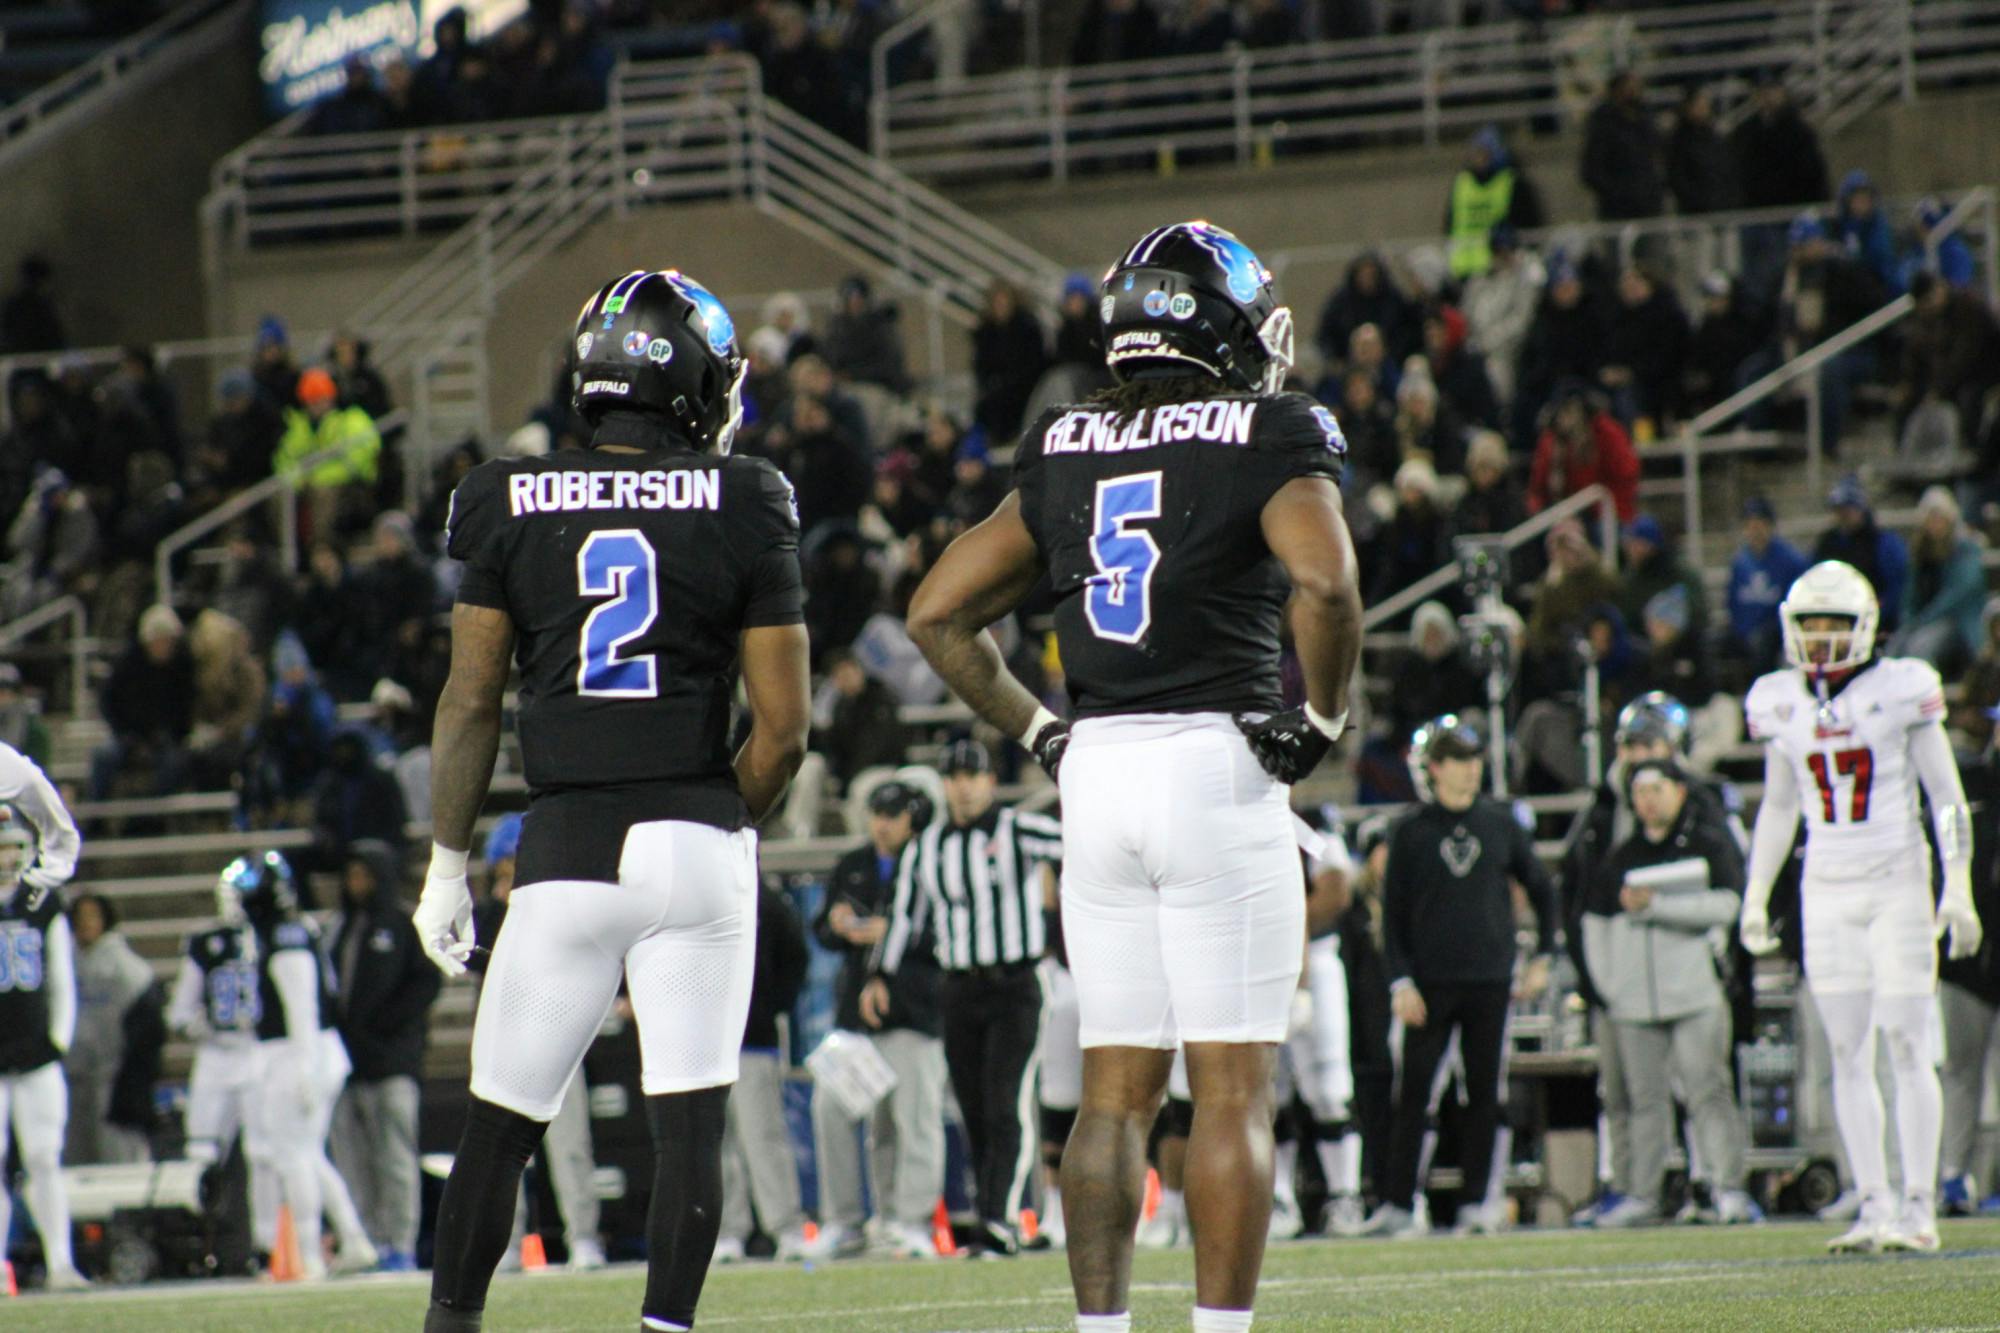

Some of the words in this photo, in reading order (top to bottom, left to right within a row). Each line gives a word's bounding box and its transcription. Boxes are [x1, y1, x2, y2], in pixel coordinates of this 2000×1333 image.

[1173, 297, 1193, 314] GP
[650, 341, 670, 359] GP
[1113, 331, 1162, 350] BUFFALO
[583, 380, 630, 395] BUFFALO
[1043, 401, 1257, 455] HENDERSON
[510, 469, 720, 517] ROBERSON
[1084, 470, 1163, 645] 5
[577, 528, 658, 698] 2
[1807, 745, 1874, 823] 17
